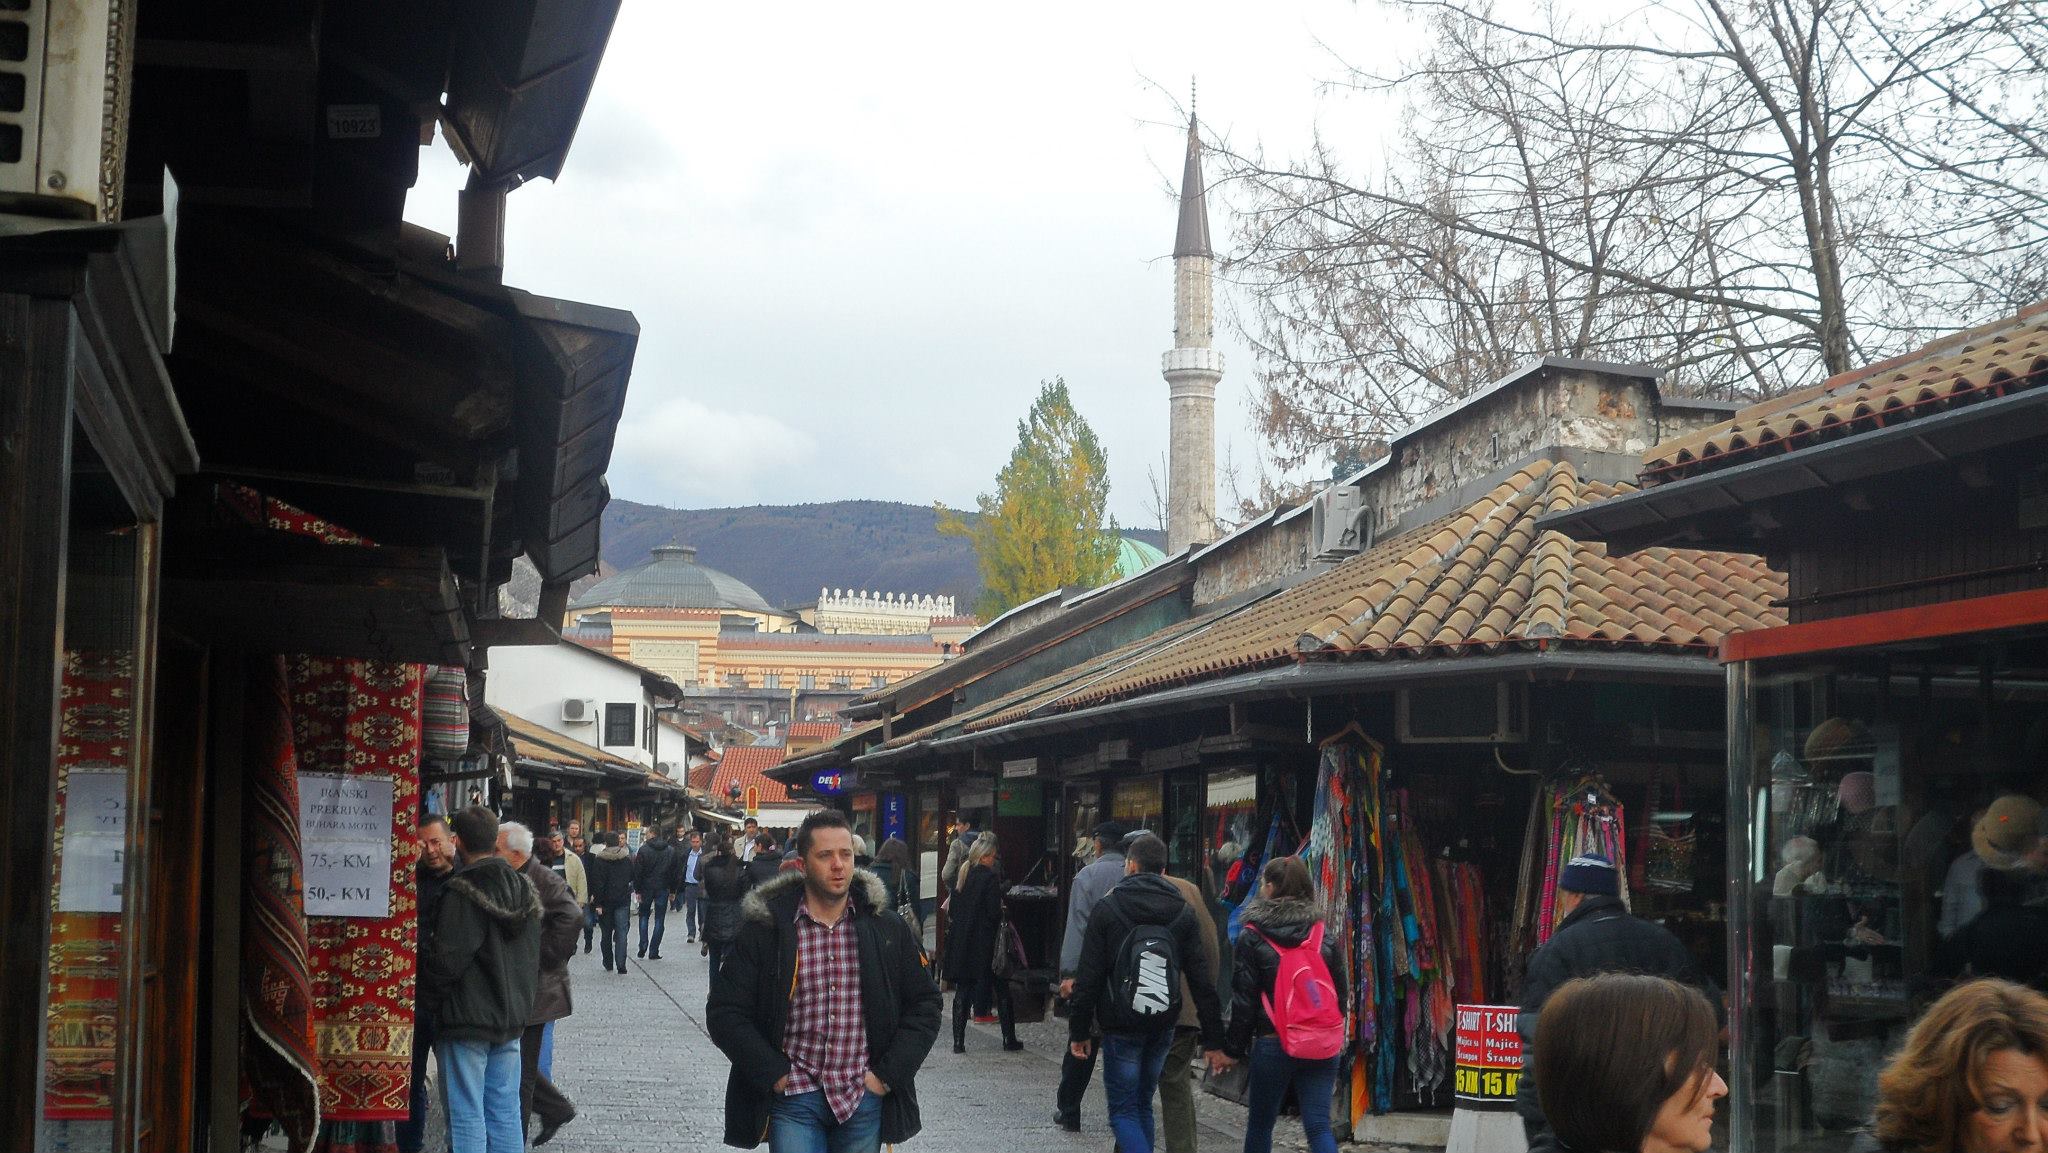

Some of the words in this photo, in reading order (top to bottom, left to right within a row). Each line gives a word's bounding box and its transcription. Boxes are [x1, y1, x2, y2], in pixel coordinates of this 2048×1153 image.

[336, 119, 376, 133] 10923
[320, 788, 368, 800] IRANSKI
[309, 804, 377, 817] PREKRIVAČ
[305, 820, 346, 829] BUHARA
[348, 821, 380, 831] MOTIV
[343, 854, 371, 868] KM
[341, 887, 371, 901] KM
[1133, 951, 1170, 1015] NIKE
[1457, 1010, 1481, 1031] T-SHIRT
[1484, 1012, 1518, 1033] T-SHI
[1486, 1049, 1524, 1065] Štampo
[1456, 1069, 1465, 1092] 15
[1465, 1070, 1479, 1094] KM
[1482, 1072, 1502, 1096] 15
[1505, 1072, 1524, 1096] K
